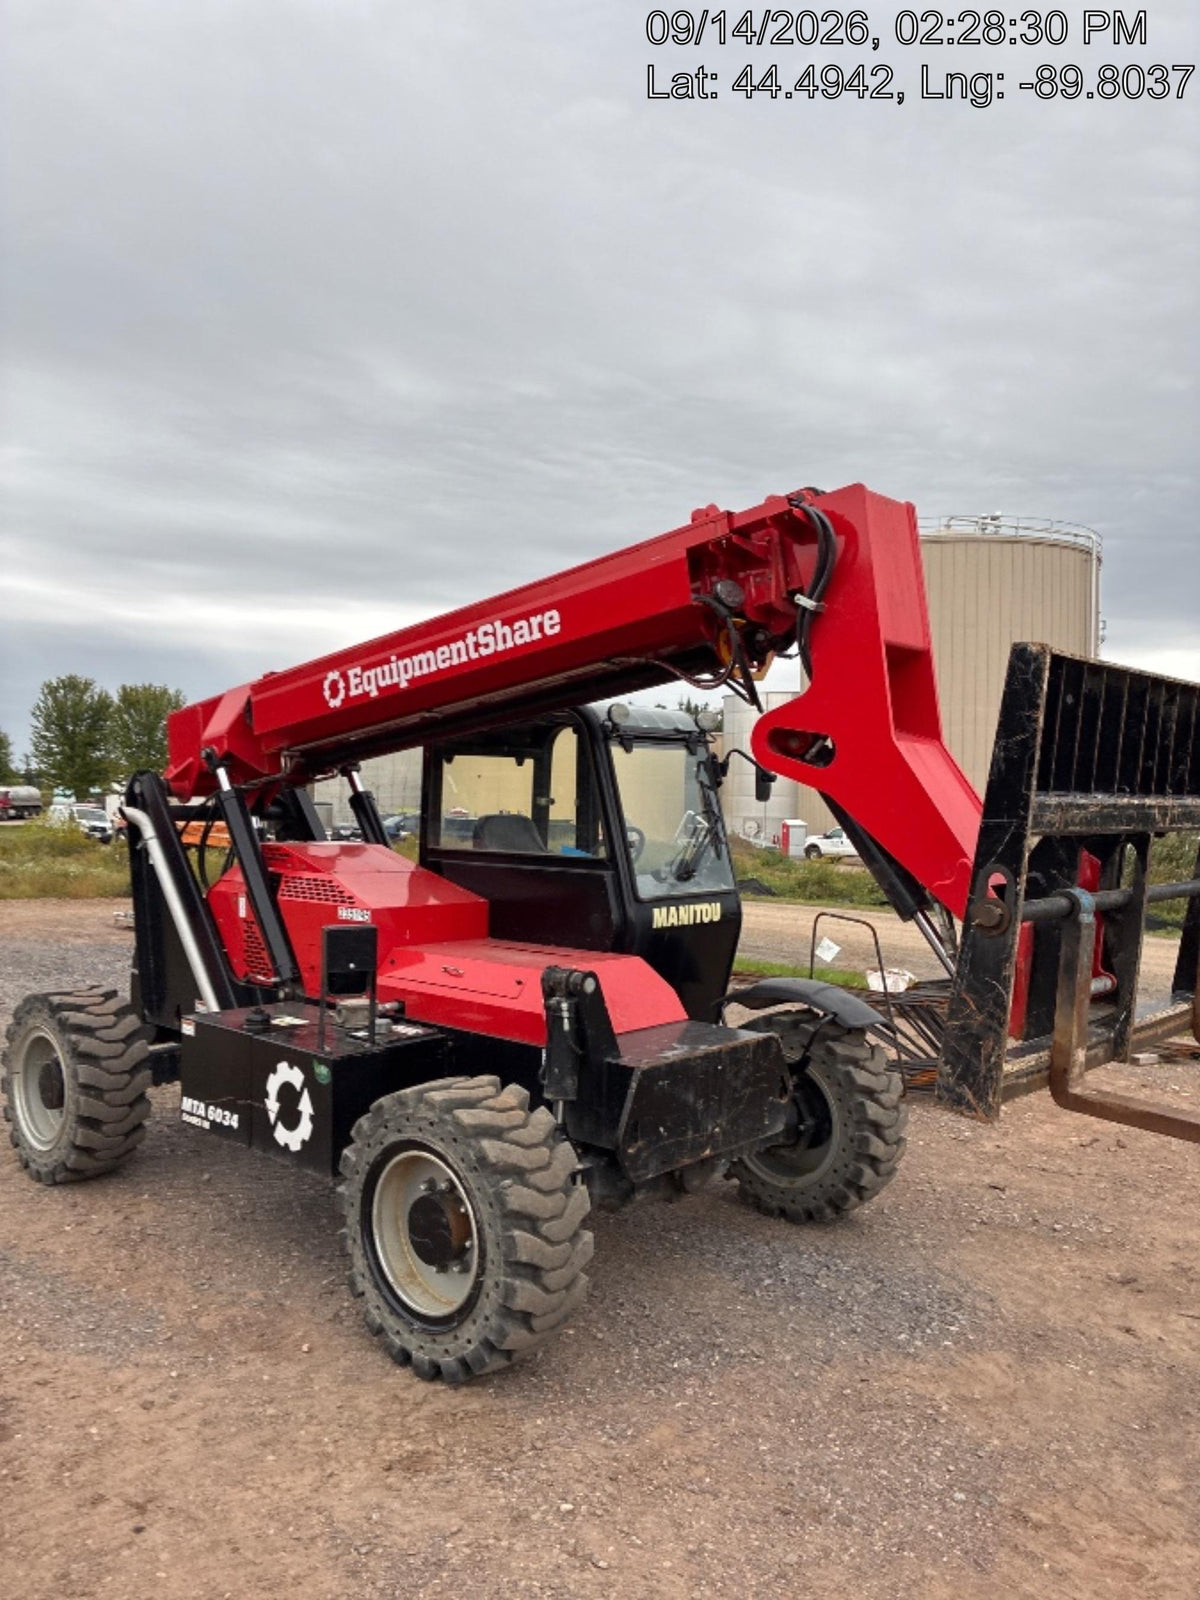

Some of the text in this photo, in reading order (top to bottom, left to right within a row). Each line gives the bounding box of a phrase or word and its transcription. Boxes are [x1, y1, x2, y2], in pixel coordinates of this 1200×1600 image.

[347, 608, 561, 698] EquipmentShare
[652, 902, 721, 929] MANITOU
[181, 1096, 206, 1118] MTA
[207, 1105, 239, 1130] 6034
